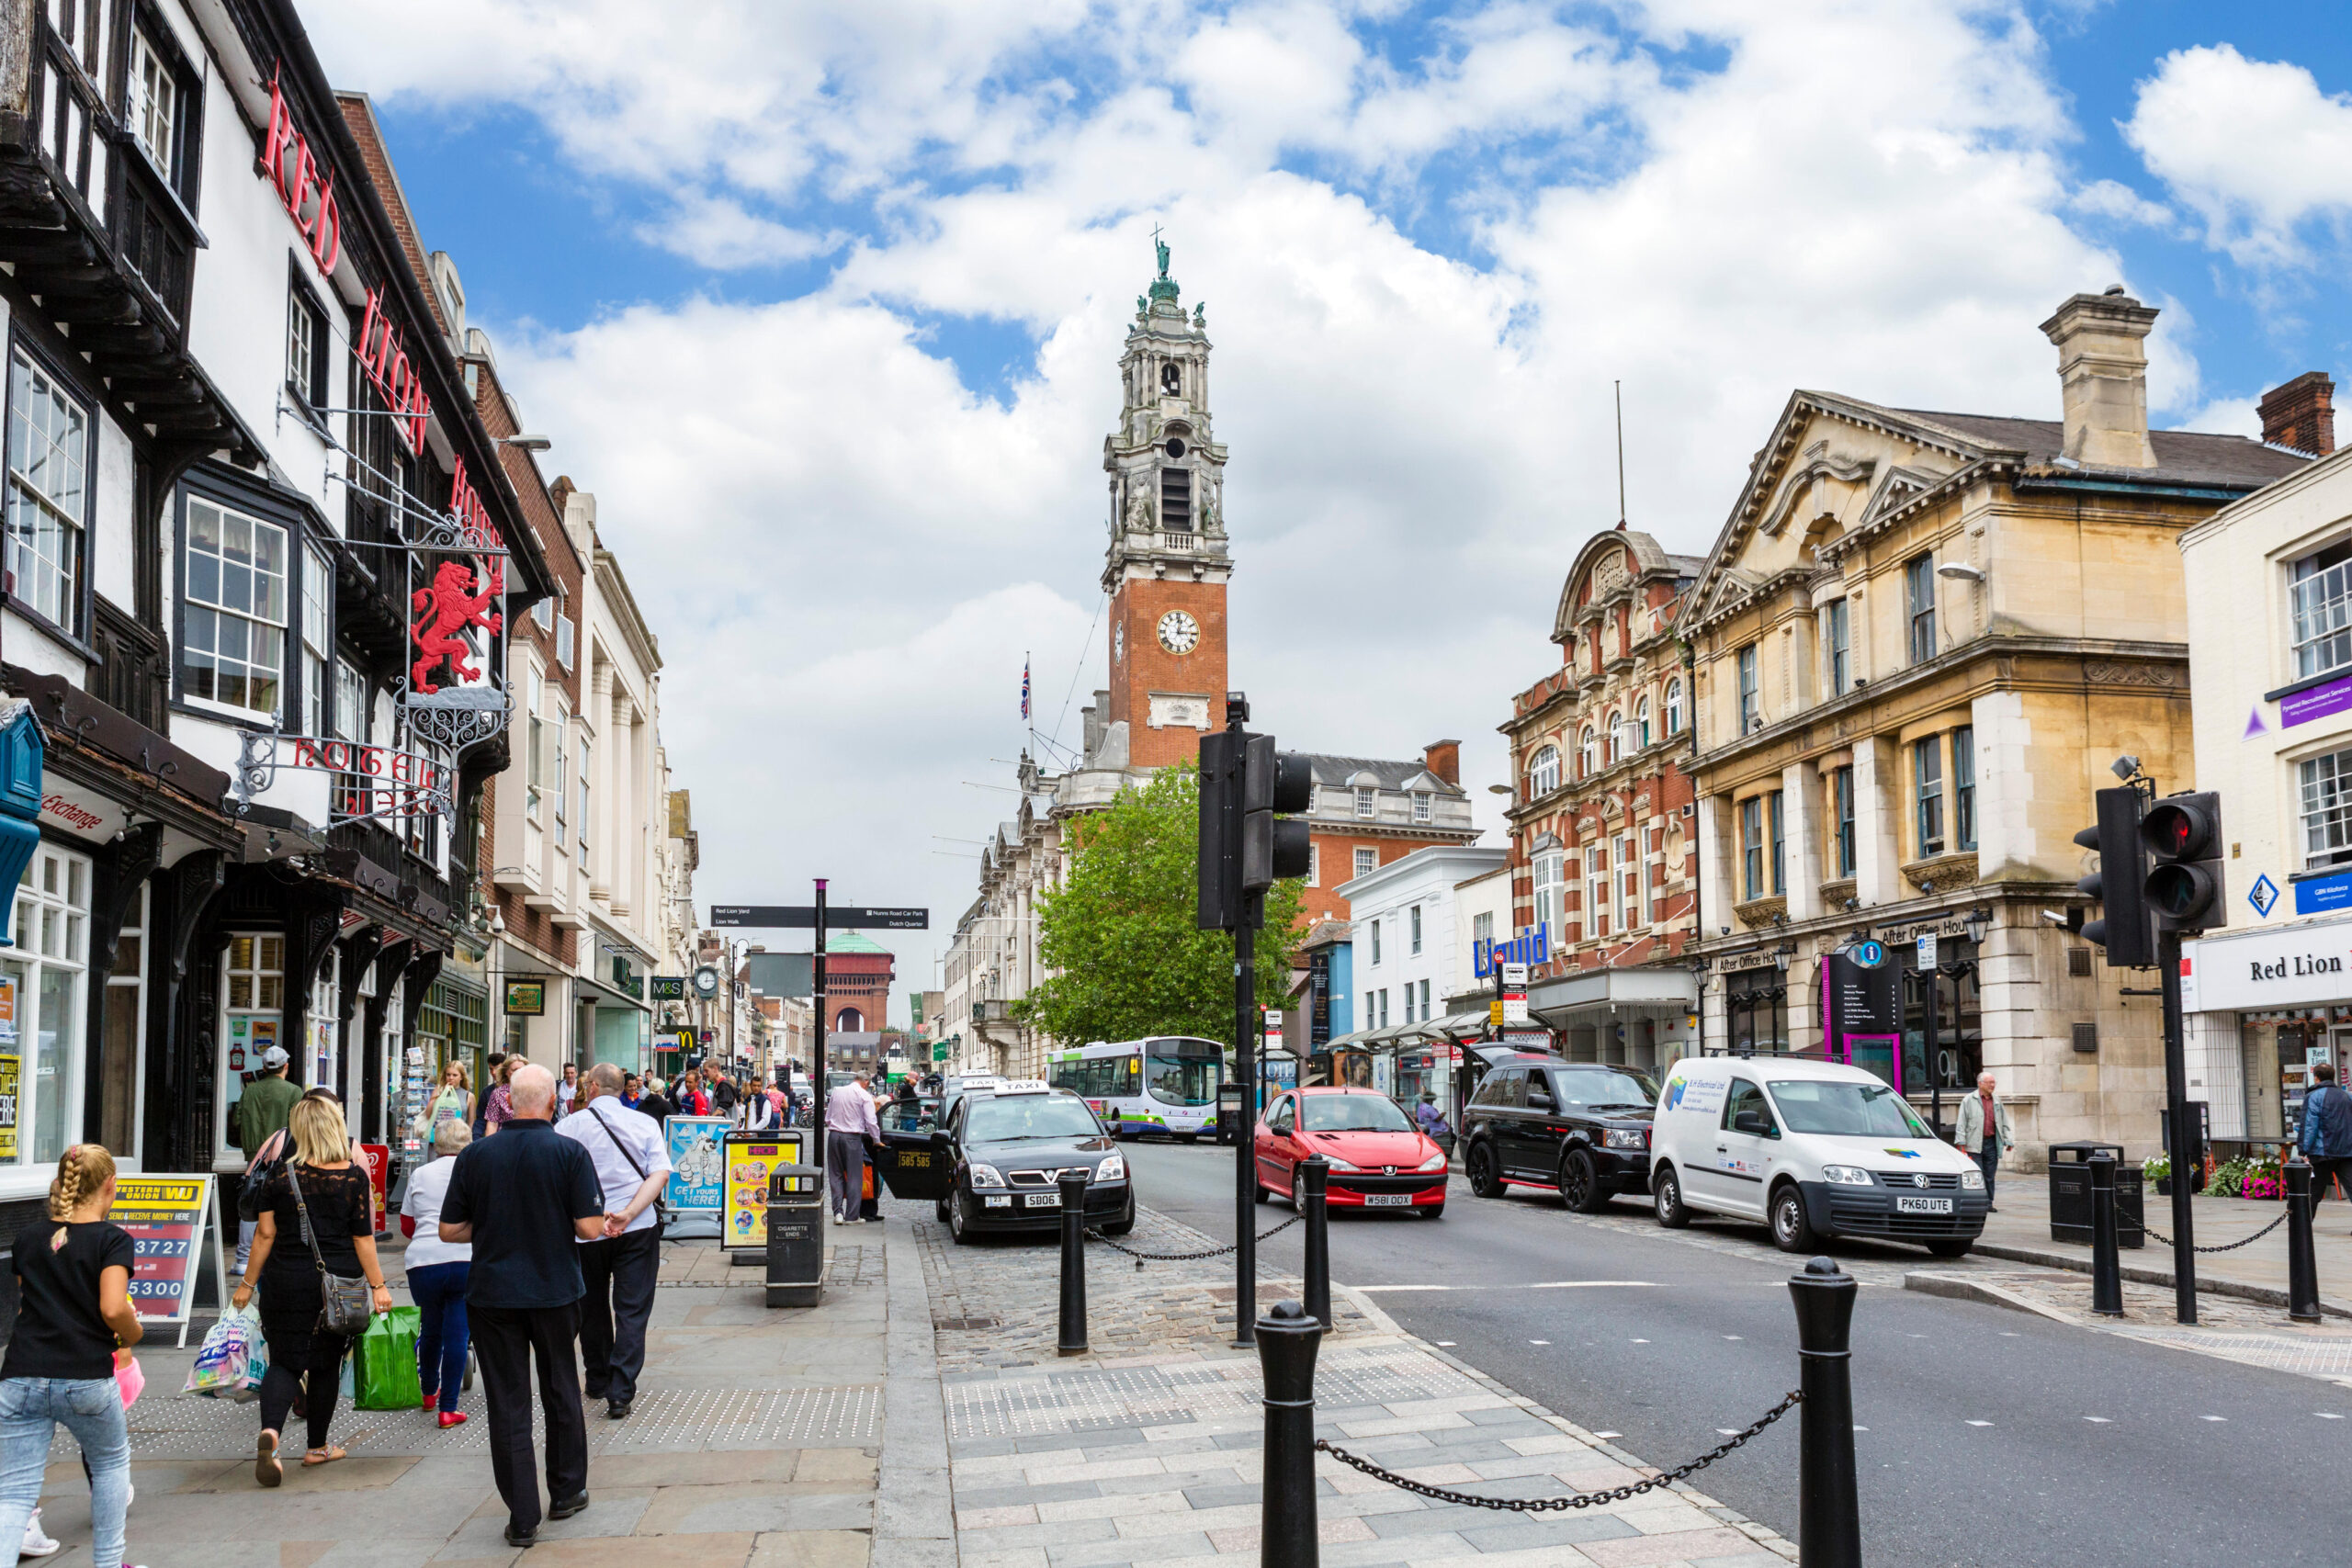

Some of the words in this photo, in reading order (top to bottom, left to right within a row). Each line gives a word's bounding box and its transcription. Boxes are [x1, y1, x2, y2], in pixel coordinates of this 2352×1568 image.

[260, 79, 339, 276] RED
[355, 287, 430, 447] LION
[2282, 702, 2301, 713] Pyramid
[2301, 693, 2331, 705] Recruitment
[2331, 686, 2352, 697] Services
[294, 738, 435, 789] HOTEL
[41, 795, 103, 829] Exchange
[1883, 930, 1906, 942] After
[1474, 921, 1551, 979] Liquid
[1720, 959, 1737, 971] After
[1740, 955, 1761, 968] Office
[2250, 957, 2288, 981] Red
[2294, 953, 2342, 976] Lion
[653, 982, 681, 994] M&S
[2312, 1049, 2326, 1057] Red
[749, 1146, 777, 1155] HEROES
[901, 1156, 915, 1167] 585
[916, 1156, 931, 1168] 585
[674, 1185, 694, 1196] GET
[683, 1195, 720, 1205] HERE!
[1368, 1196, 1389, 1204] W581
[1391, 1196, 1408, 1204] ODX
[1902, 1199, 1928, 1210] PK60
[1930, 1200, 1949, 1211] UTE
[152, 1213, 175, 1221] MONEY
[175, 1213, 190, 1221] HERE
